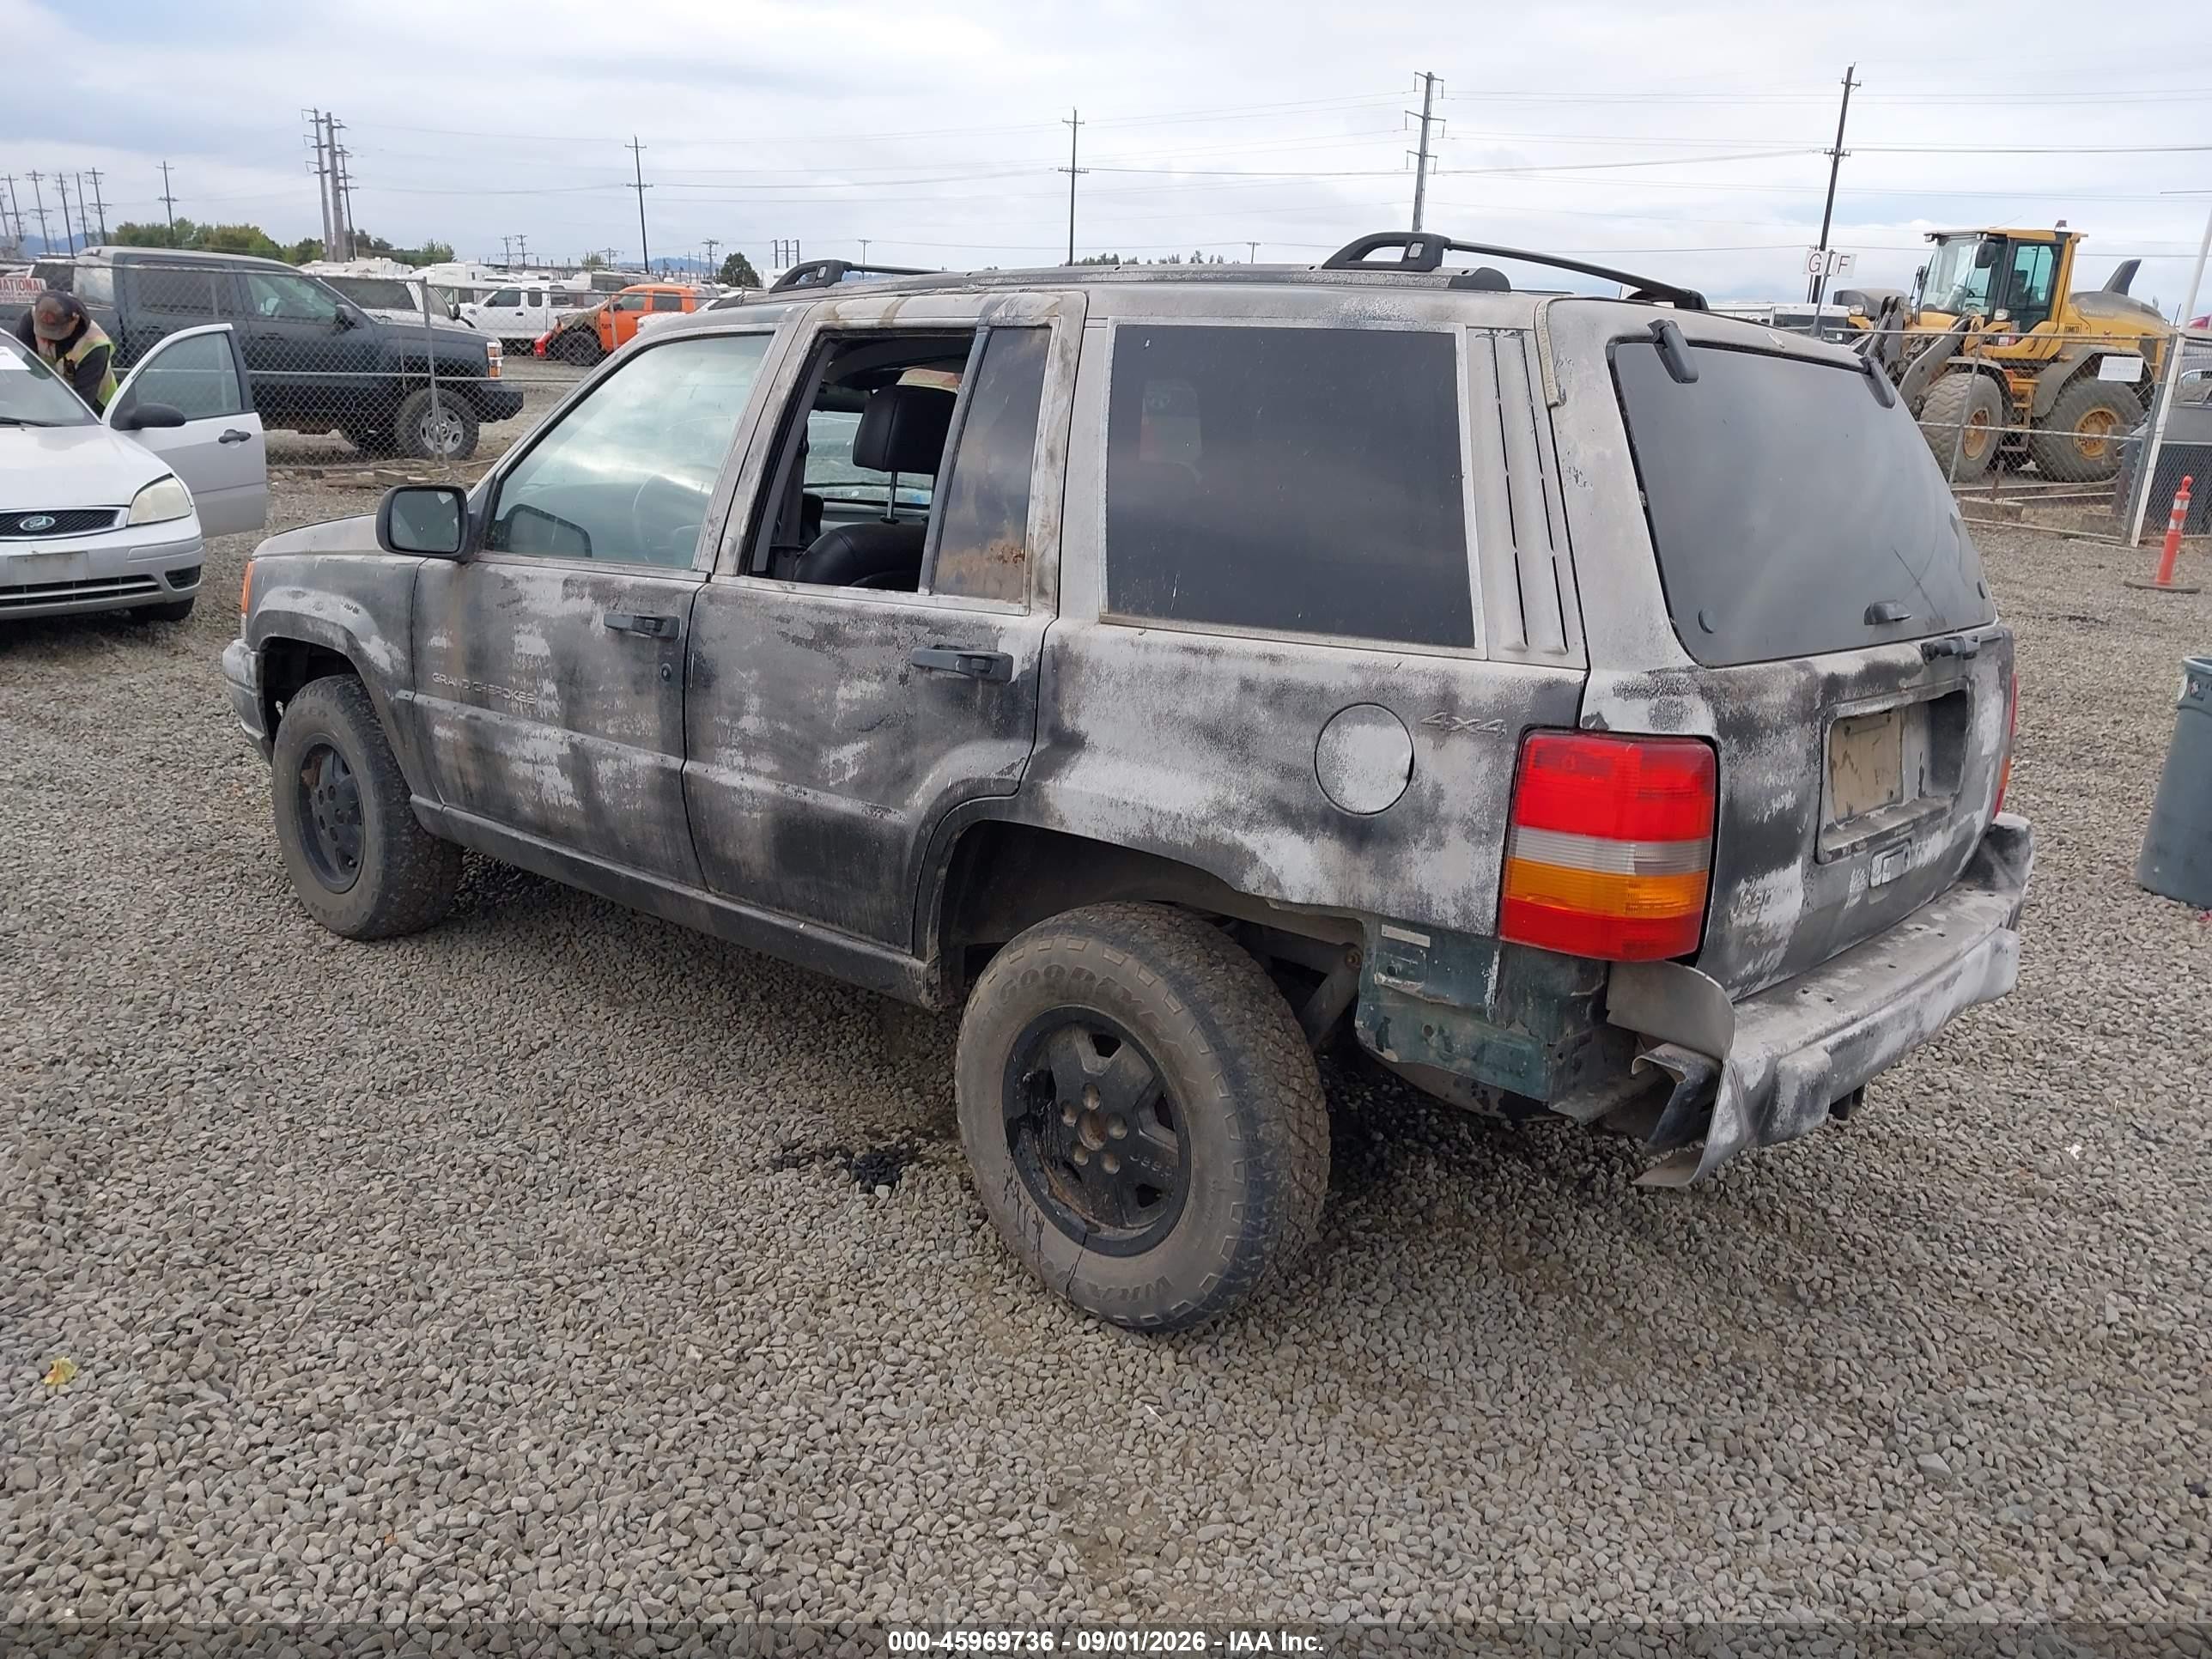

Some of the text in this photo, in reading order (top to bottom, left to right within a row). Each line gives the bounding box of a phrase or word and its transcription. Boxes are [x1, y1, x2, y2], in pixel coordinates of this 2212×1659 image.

[1808, 252, 1822, 273] G
[1837, 255, 1851, 275] F
[432, 672, 537, 704] GRAND CHEROKEE
